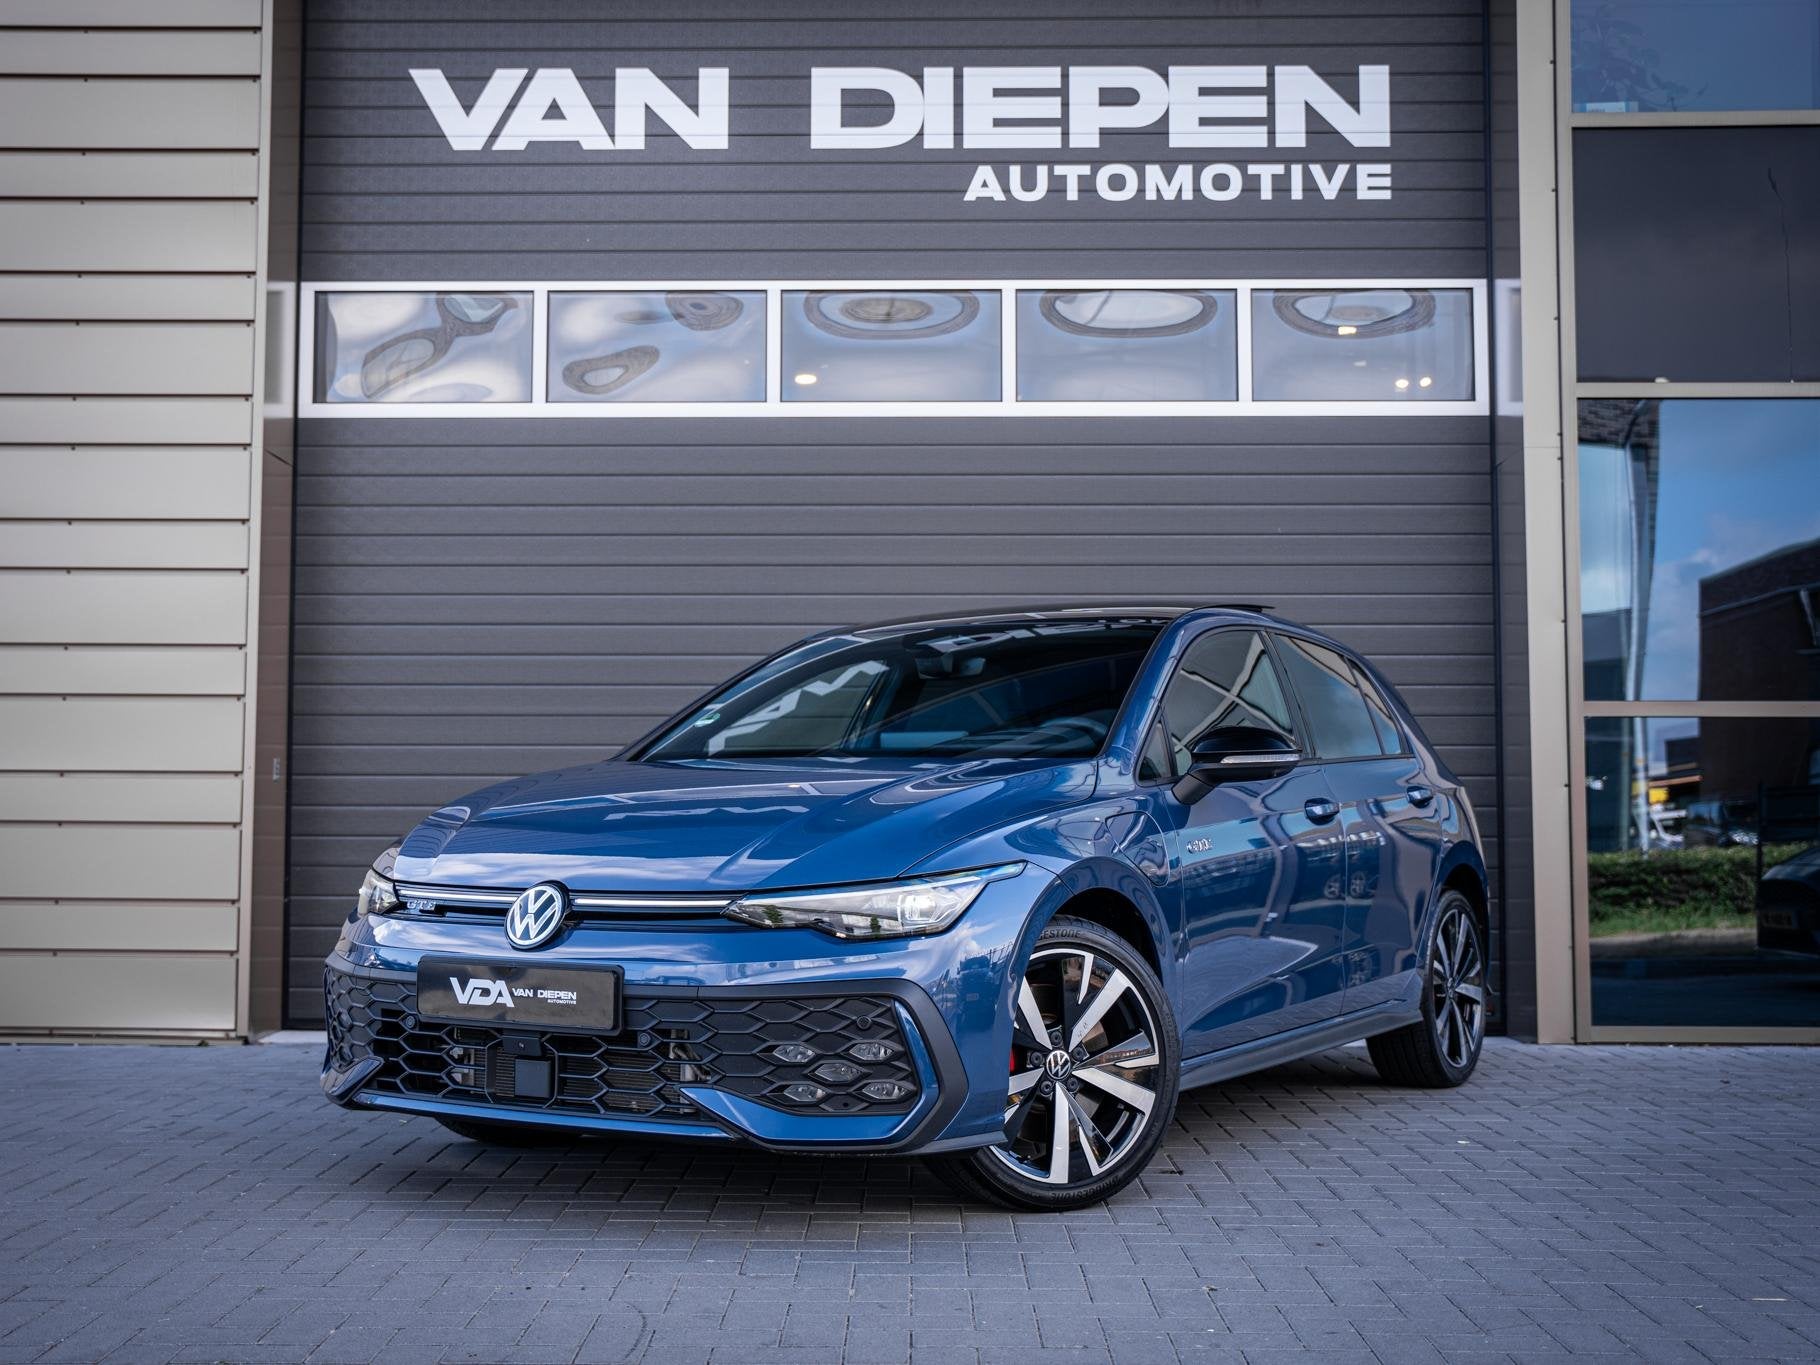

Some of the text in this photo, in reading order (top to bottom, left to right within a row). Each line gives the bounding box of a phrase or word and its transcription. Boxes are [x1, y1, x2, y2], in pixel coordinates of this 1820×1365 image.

[408, 64, 1391, 152] VAN DIEPEN
[963, 163, 1392, 202] AUTOMOTIVE
[449, 977, 515, 1008] VDA
[512, 987, 577, 1000] VAN DIEPEN
